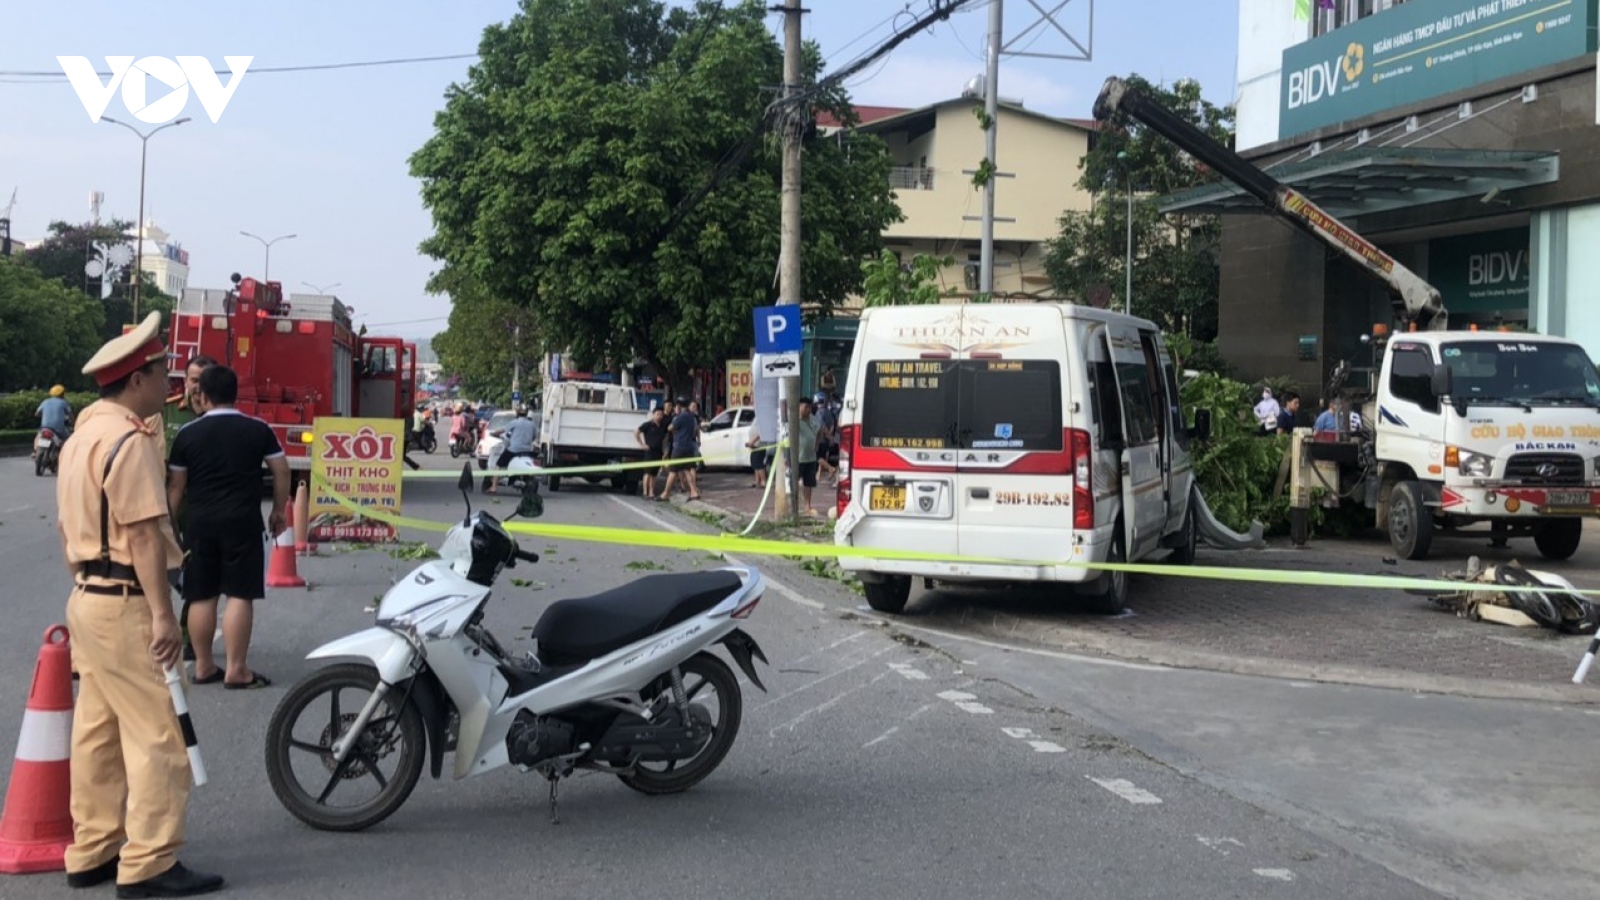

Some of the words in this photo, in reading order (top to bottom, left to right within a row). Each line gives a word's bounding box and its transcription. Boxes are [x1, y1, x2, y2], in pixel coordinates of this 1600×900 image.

[1414, 23, 1435, 40] TMCP
[1288, 54, 1343, 109] BIDV
[1469, 249, 1523, 285] BIDV
[767, 314, 787, 343] P
[995, 326, 1029, 337] AN
[902, 362, 914, 374] AN
[915, 362, 943, 374] TRAVEL
[321, 427, 395, 460] XÔI
[326, 467, 353, 480] THỊT
[359, 467, 389, 477] KHO
[881, 488, 900, 499] 29B
